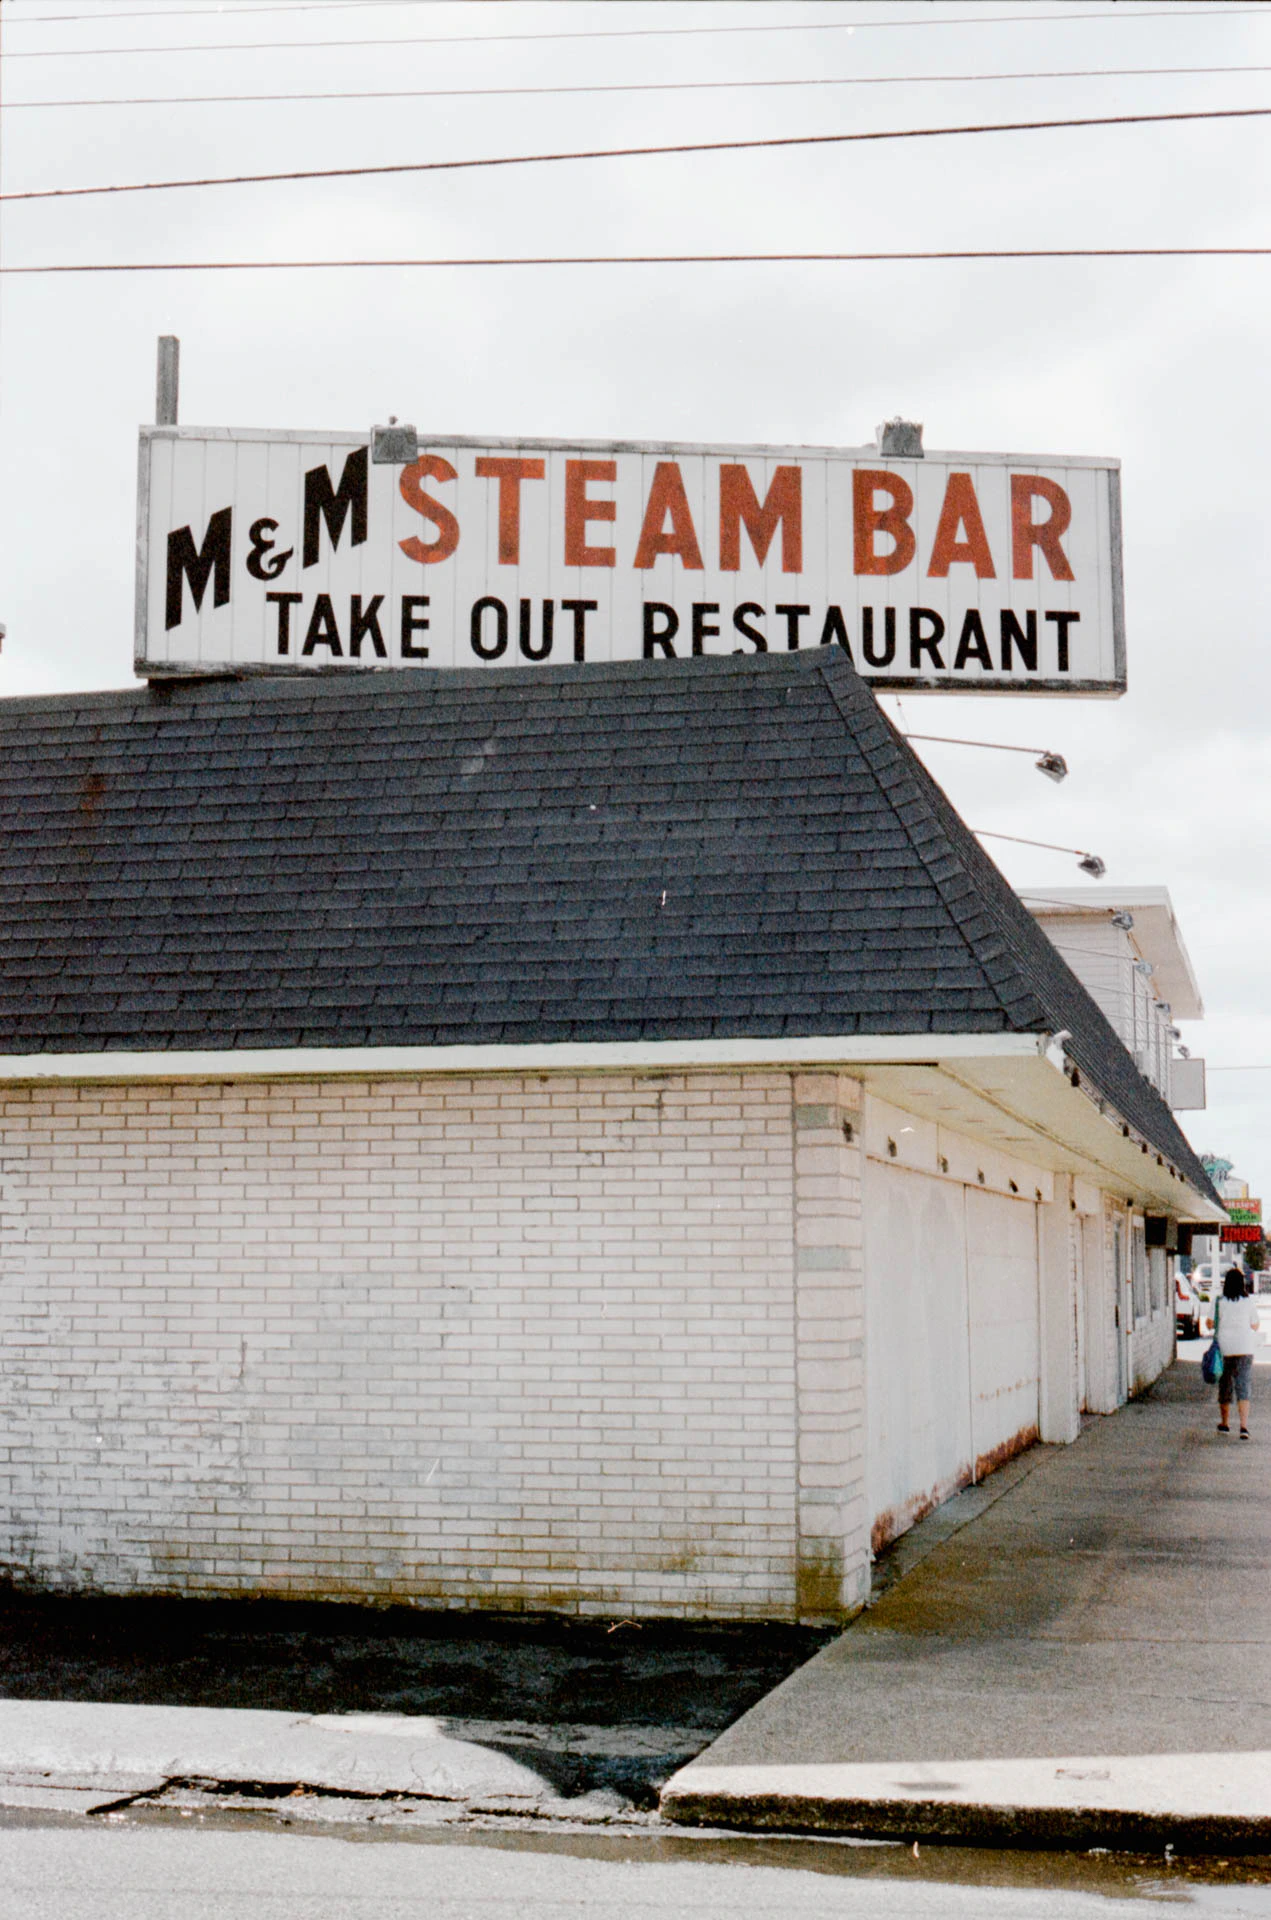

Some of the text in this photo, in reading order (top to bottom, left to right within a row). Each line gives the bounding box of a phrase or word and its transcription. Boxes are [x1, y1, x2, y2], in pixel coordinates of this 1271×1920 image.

[398, 454, 803, 574] STEAM
[852, 469, 1076, 581] BAR
[266, 592, 430, 659] TAKE
[470, 597, 598, 662] OUT
